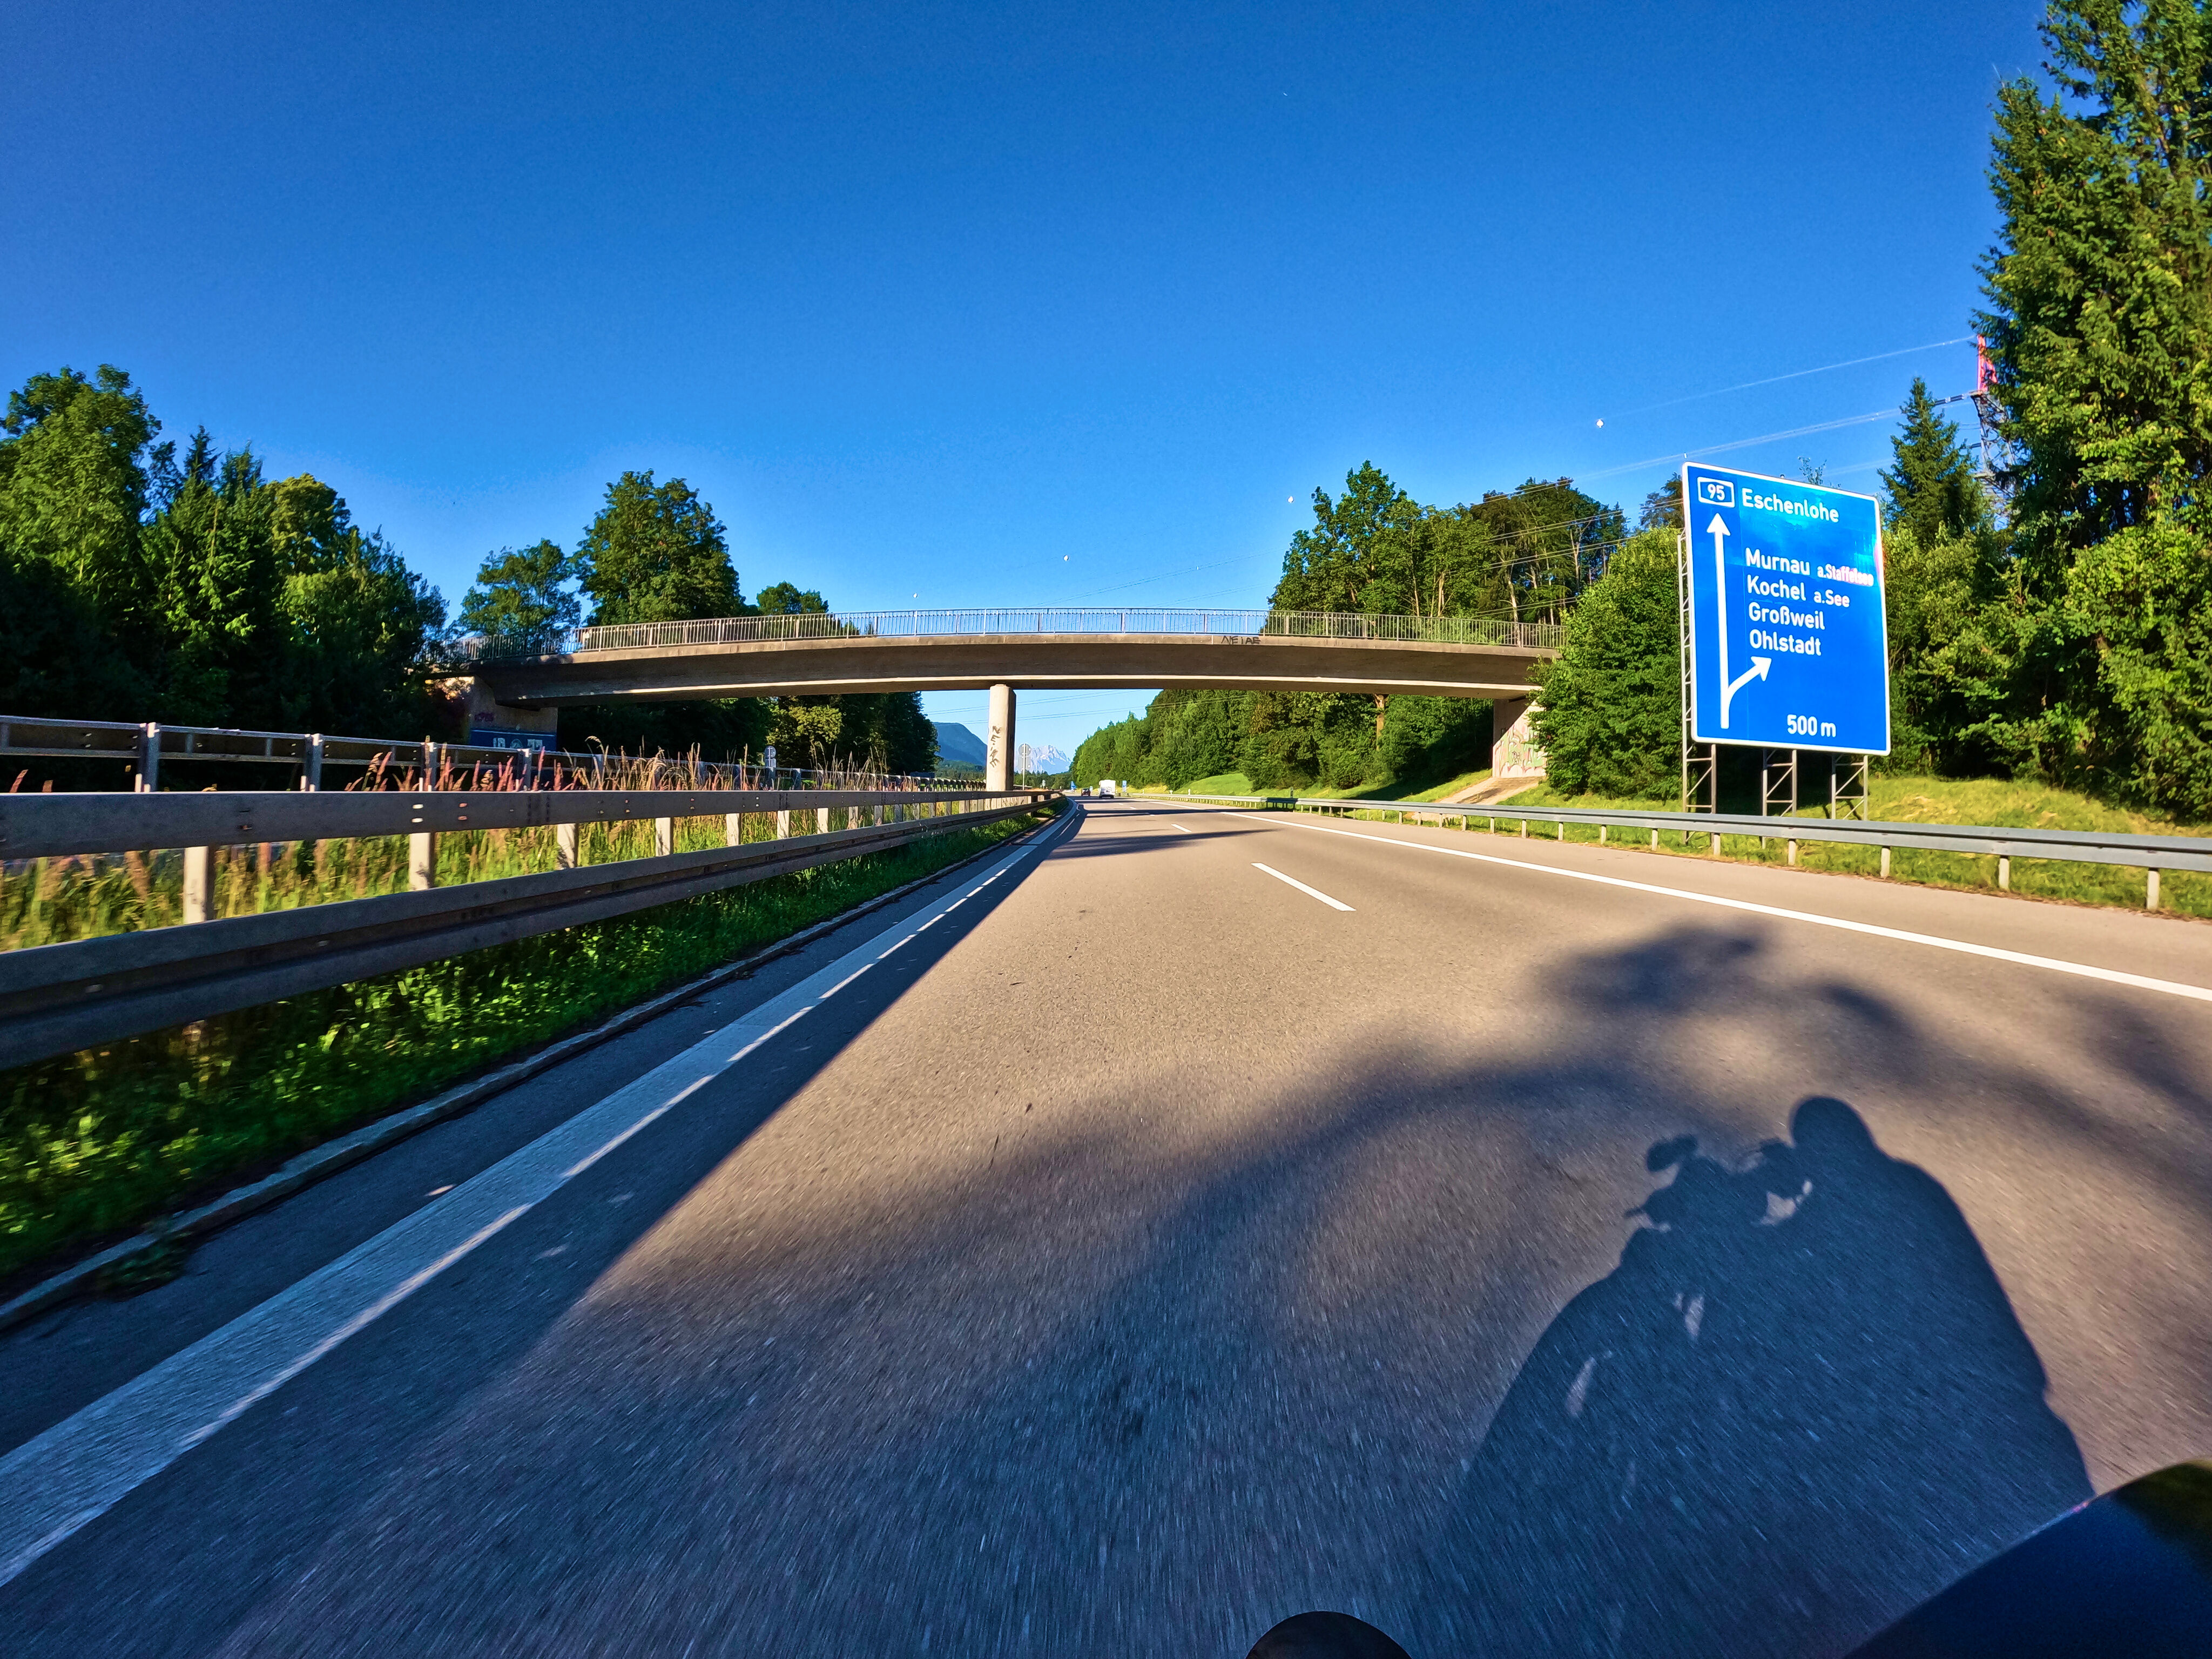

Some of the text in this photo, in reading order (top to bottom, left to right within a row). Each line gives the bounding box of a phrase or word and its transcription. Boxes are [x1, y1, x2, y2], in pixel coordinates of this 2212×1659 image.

[1707, 483, 1725, 501] 95
[1742, 487, 1839, 523] Eschenlohe
[1745, 547, 1810, 575] Murnau
[1747, 574, 1850, 608] Kochel a.See
[1749, 602, 1825, 630] Großweil
[1749, 629, 1822, 656] Ohlstadt
[1787, 714, 1836, 738] 500 m
